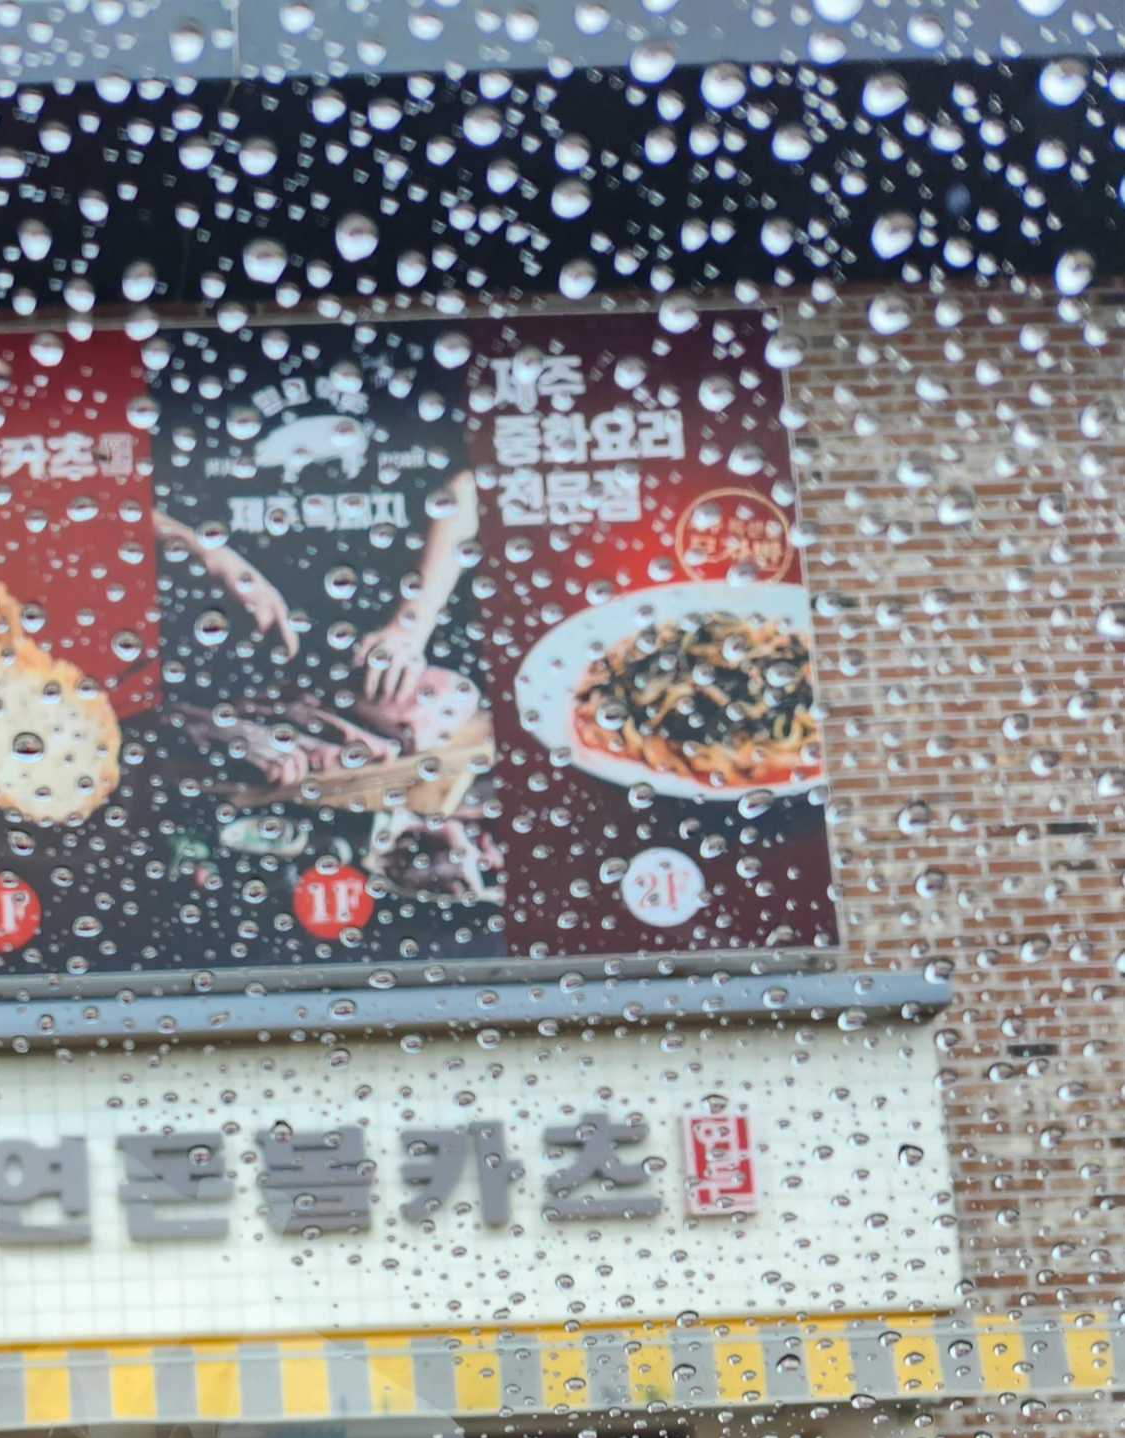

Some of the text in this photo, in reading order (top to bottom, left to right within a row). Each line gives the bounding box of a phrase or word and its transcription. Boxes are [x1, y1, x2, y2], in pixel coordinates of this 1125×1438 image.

[493, 408, 685, 466] 중화요리
[497, 469, 642, 527] 전문점
[308, 877, 364, 924] 1F
